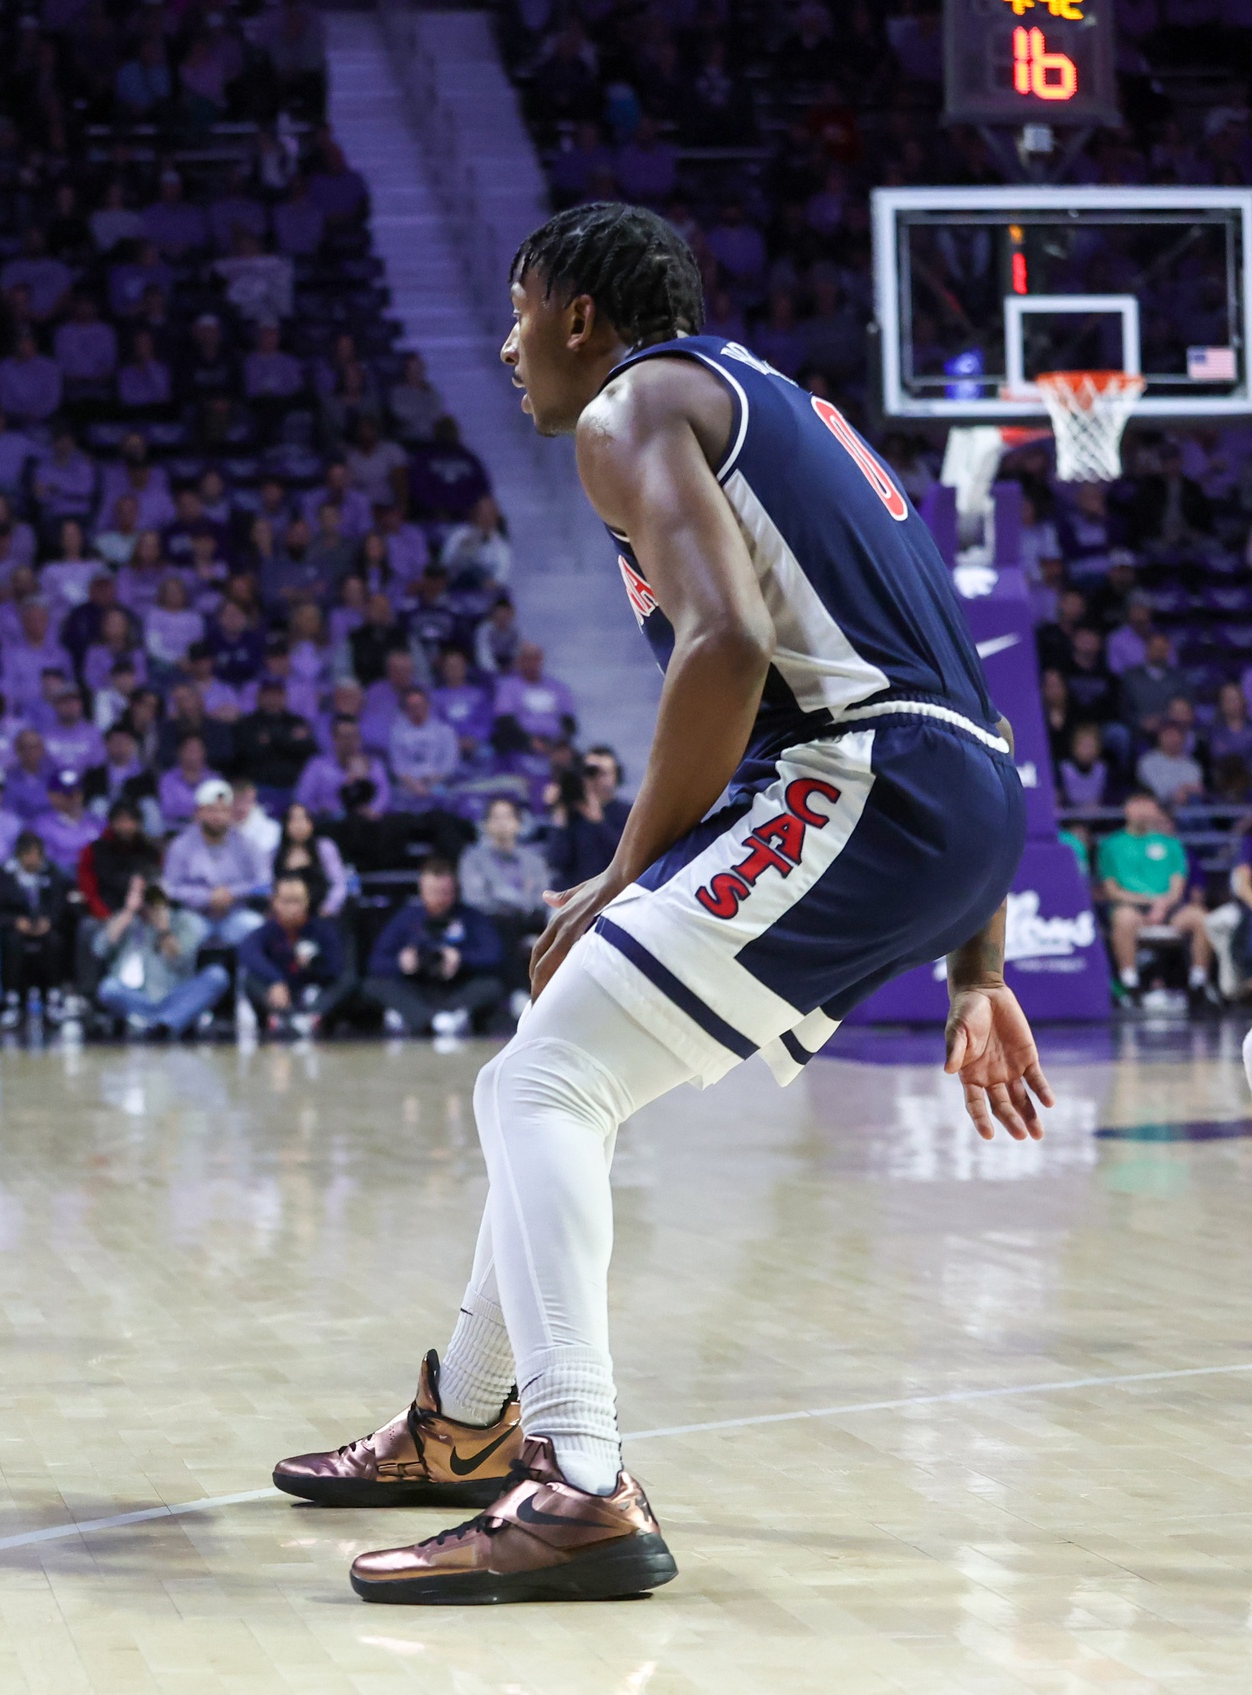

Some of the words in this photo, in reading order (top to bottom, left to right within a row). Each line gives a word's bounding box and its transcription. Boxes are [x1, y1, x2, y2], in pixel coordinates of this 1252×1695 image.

[1012, 26, 1078, 100] 16
[810, 395, 908, 521] 0
[695, 777, 842, 920] CATS
